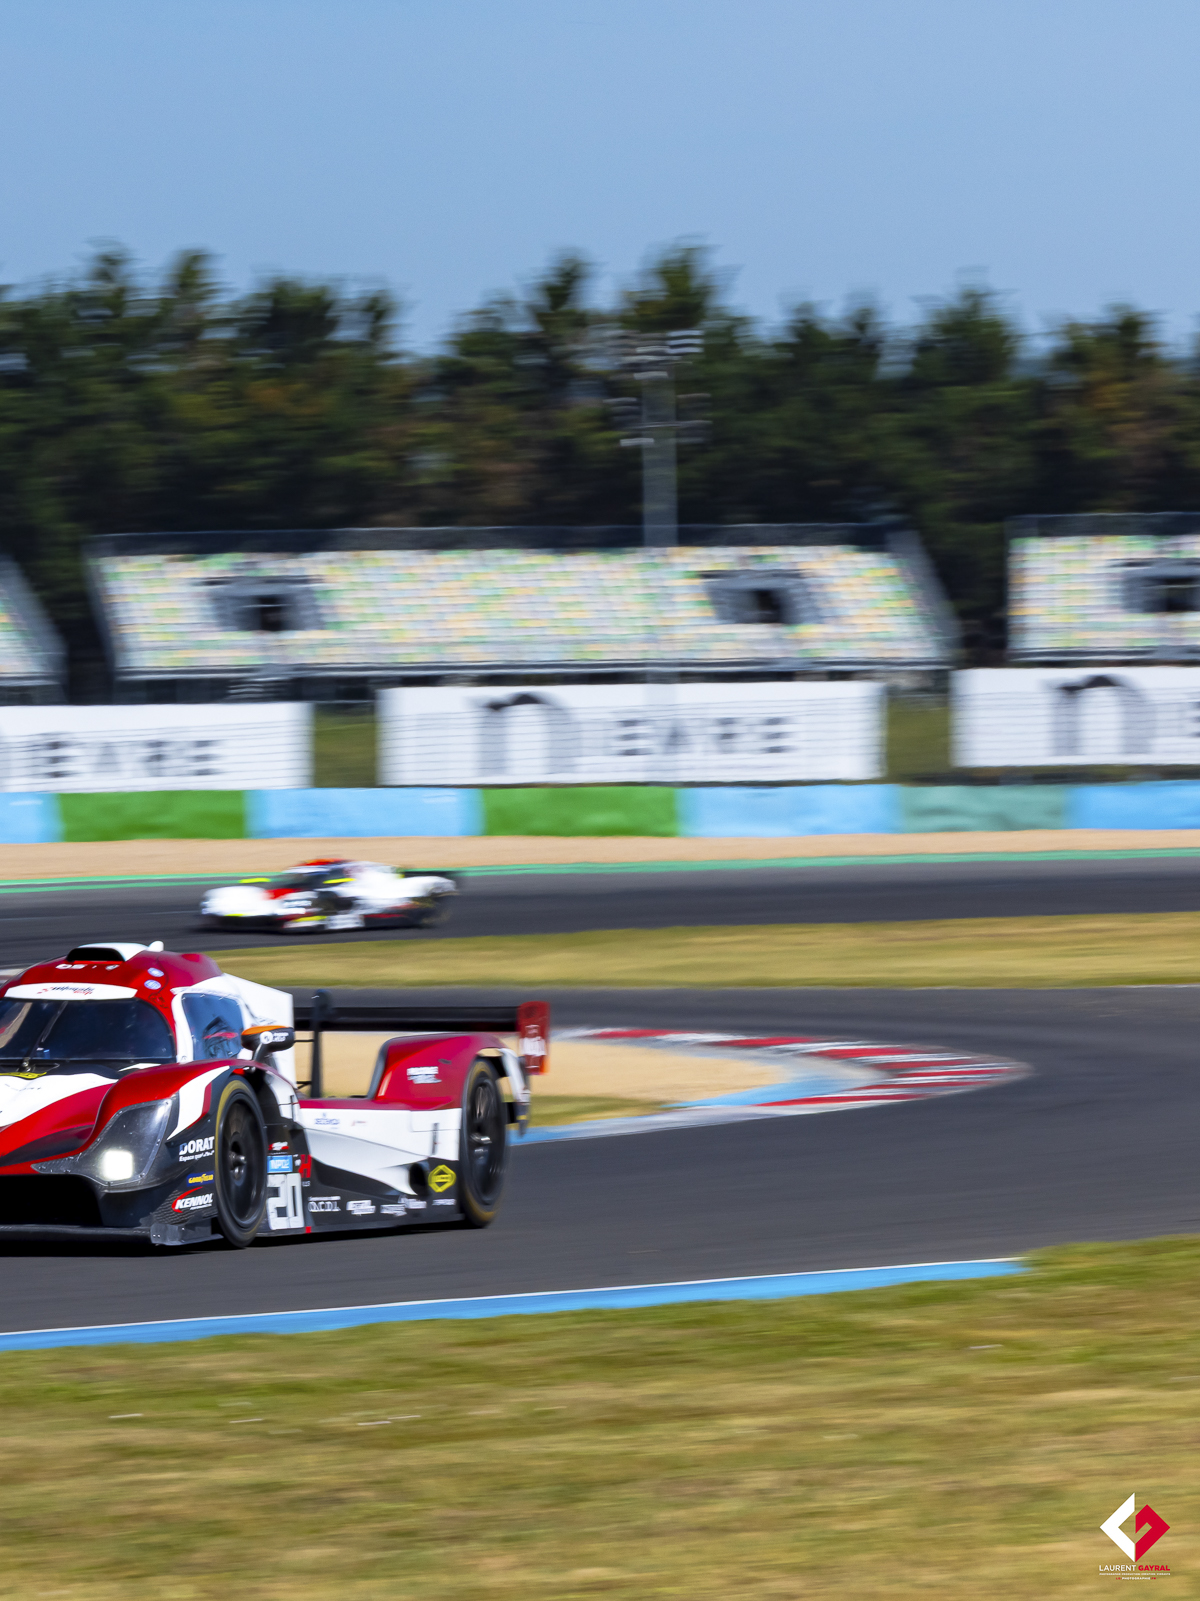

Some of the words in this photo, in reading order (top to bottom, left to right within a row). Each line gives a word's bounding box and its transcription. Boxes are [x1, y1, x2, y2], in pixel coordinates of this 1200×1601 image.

[179, 1136, 215, 1156] DORAT
[174, 1193, 214, 1210] KENNOL
[266, 1173, 305, 1231] 20
